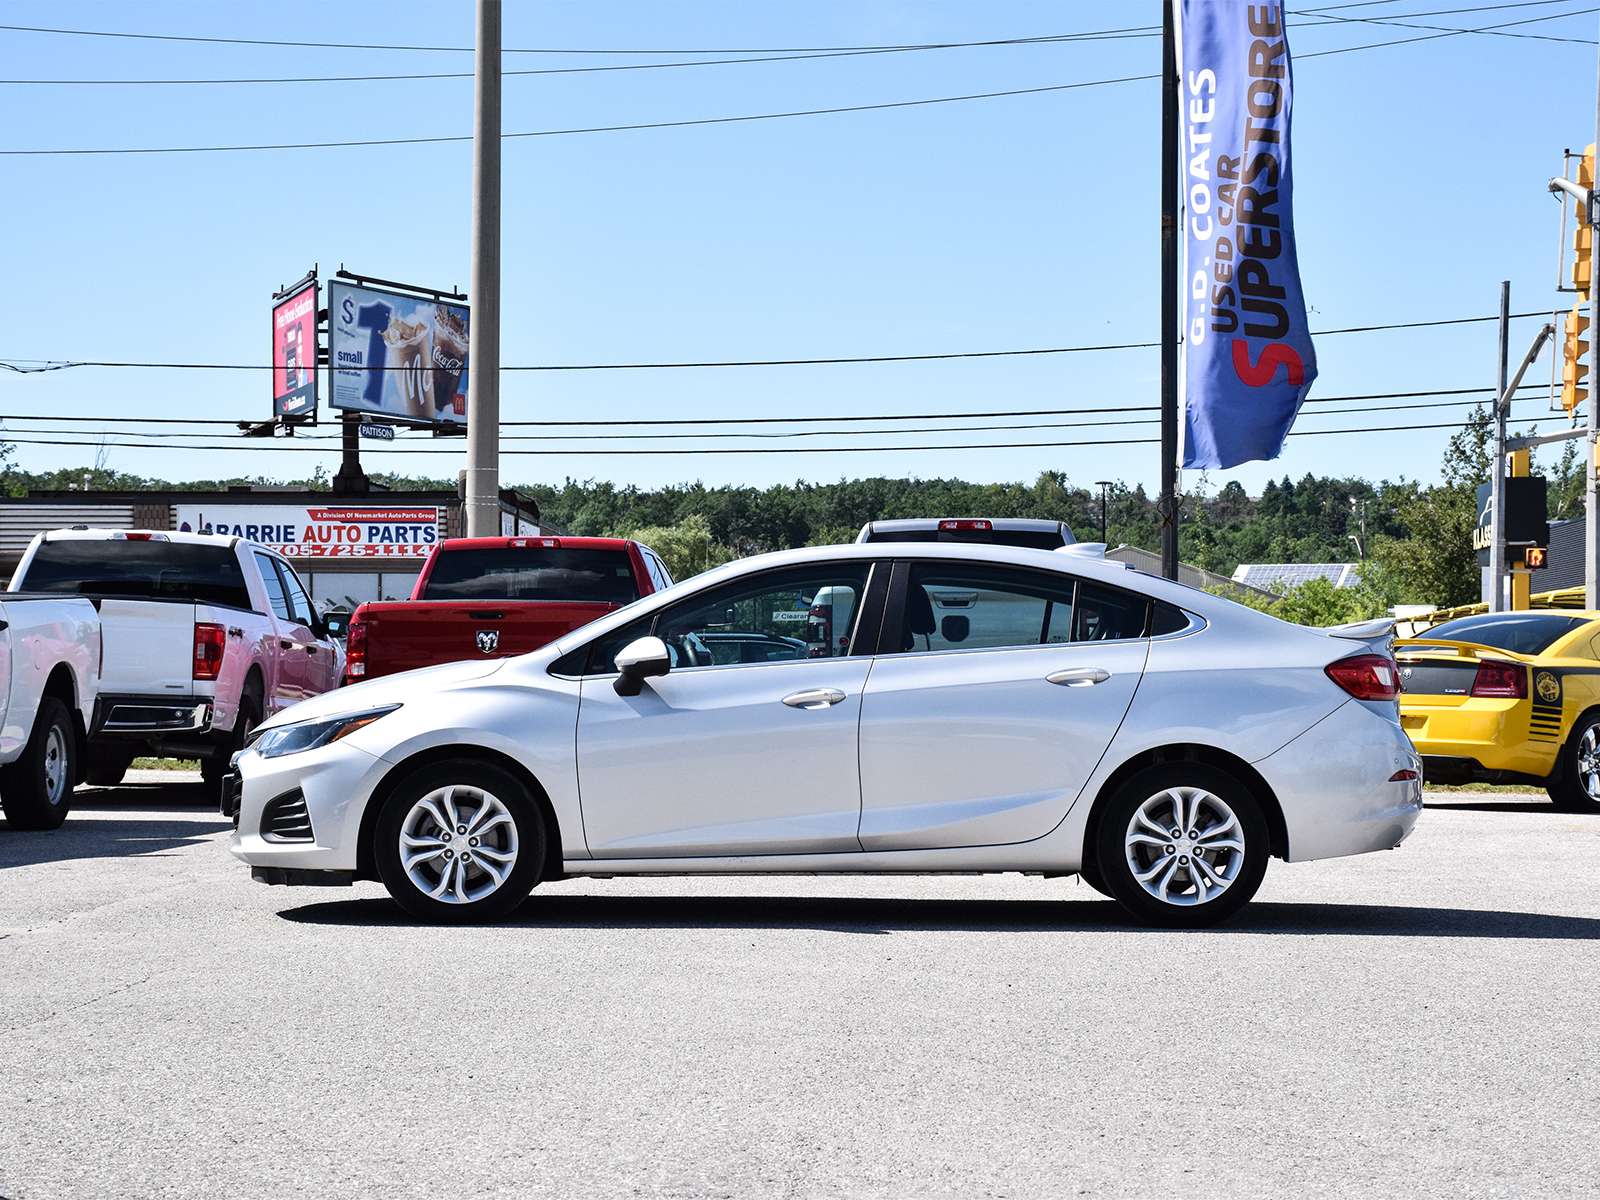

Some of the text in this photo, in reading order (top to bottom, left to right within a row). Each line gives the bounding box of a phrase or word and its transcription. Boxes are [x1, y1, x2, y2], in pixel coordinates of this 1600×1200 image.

[1232, 5, 1304, 388] SUPERSTORE
[1189, 68, 1216, 346] G.D. COATES
[1211, 154, 1241, 333] USED CAR
[337, 350, 363, 365] small
[362, 426, 393, 438] PATTISON
[418, 512, 435, 520] Group
[216, 524, 436, 543] BARRIE AUTO PARTS
